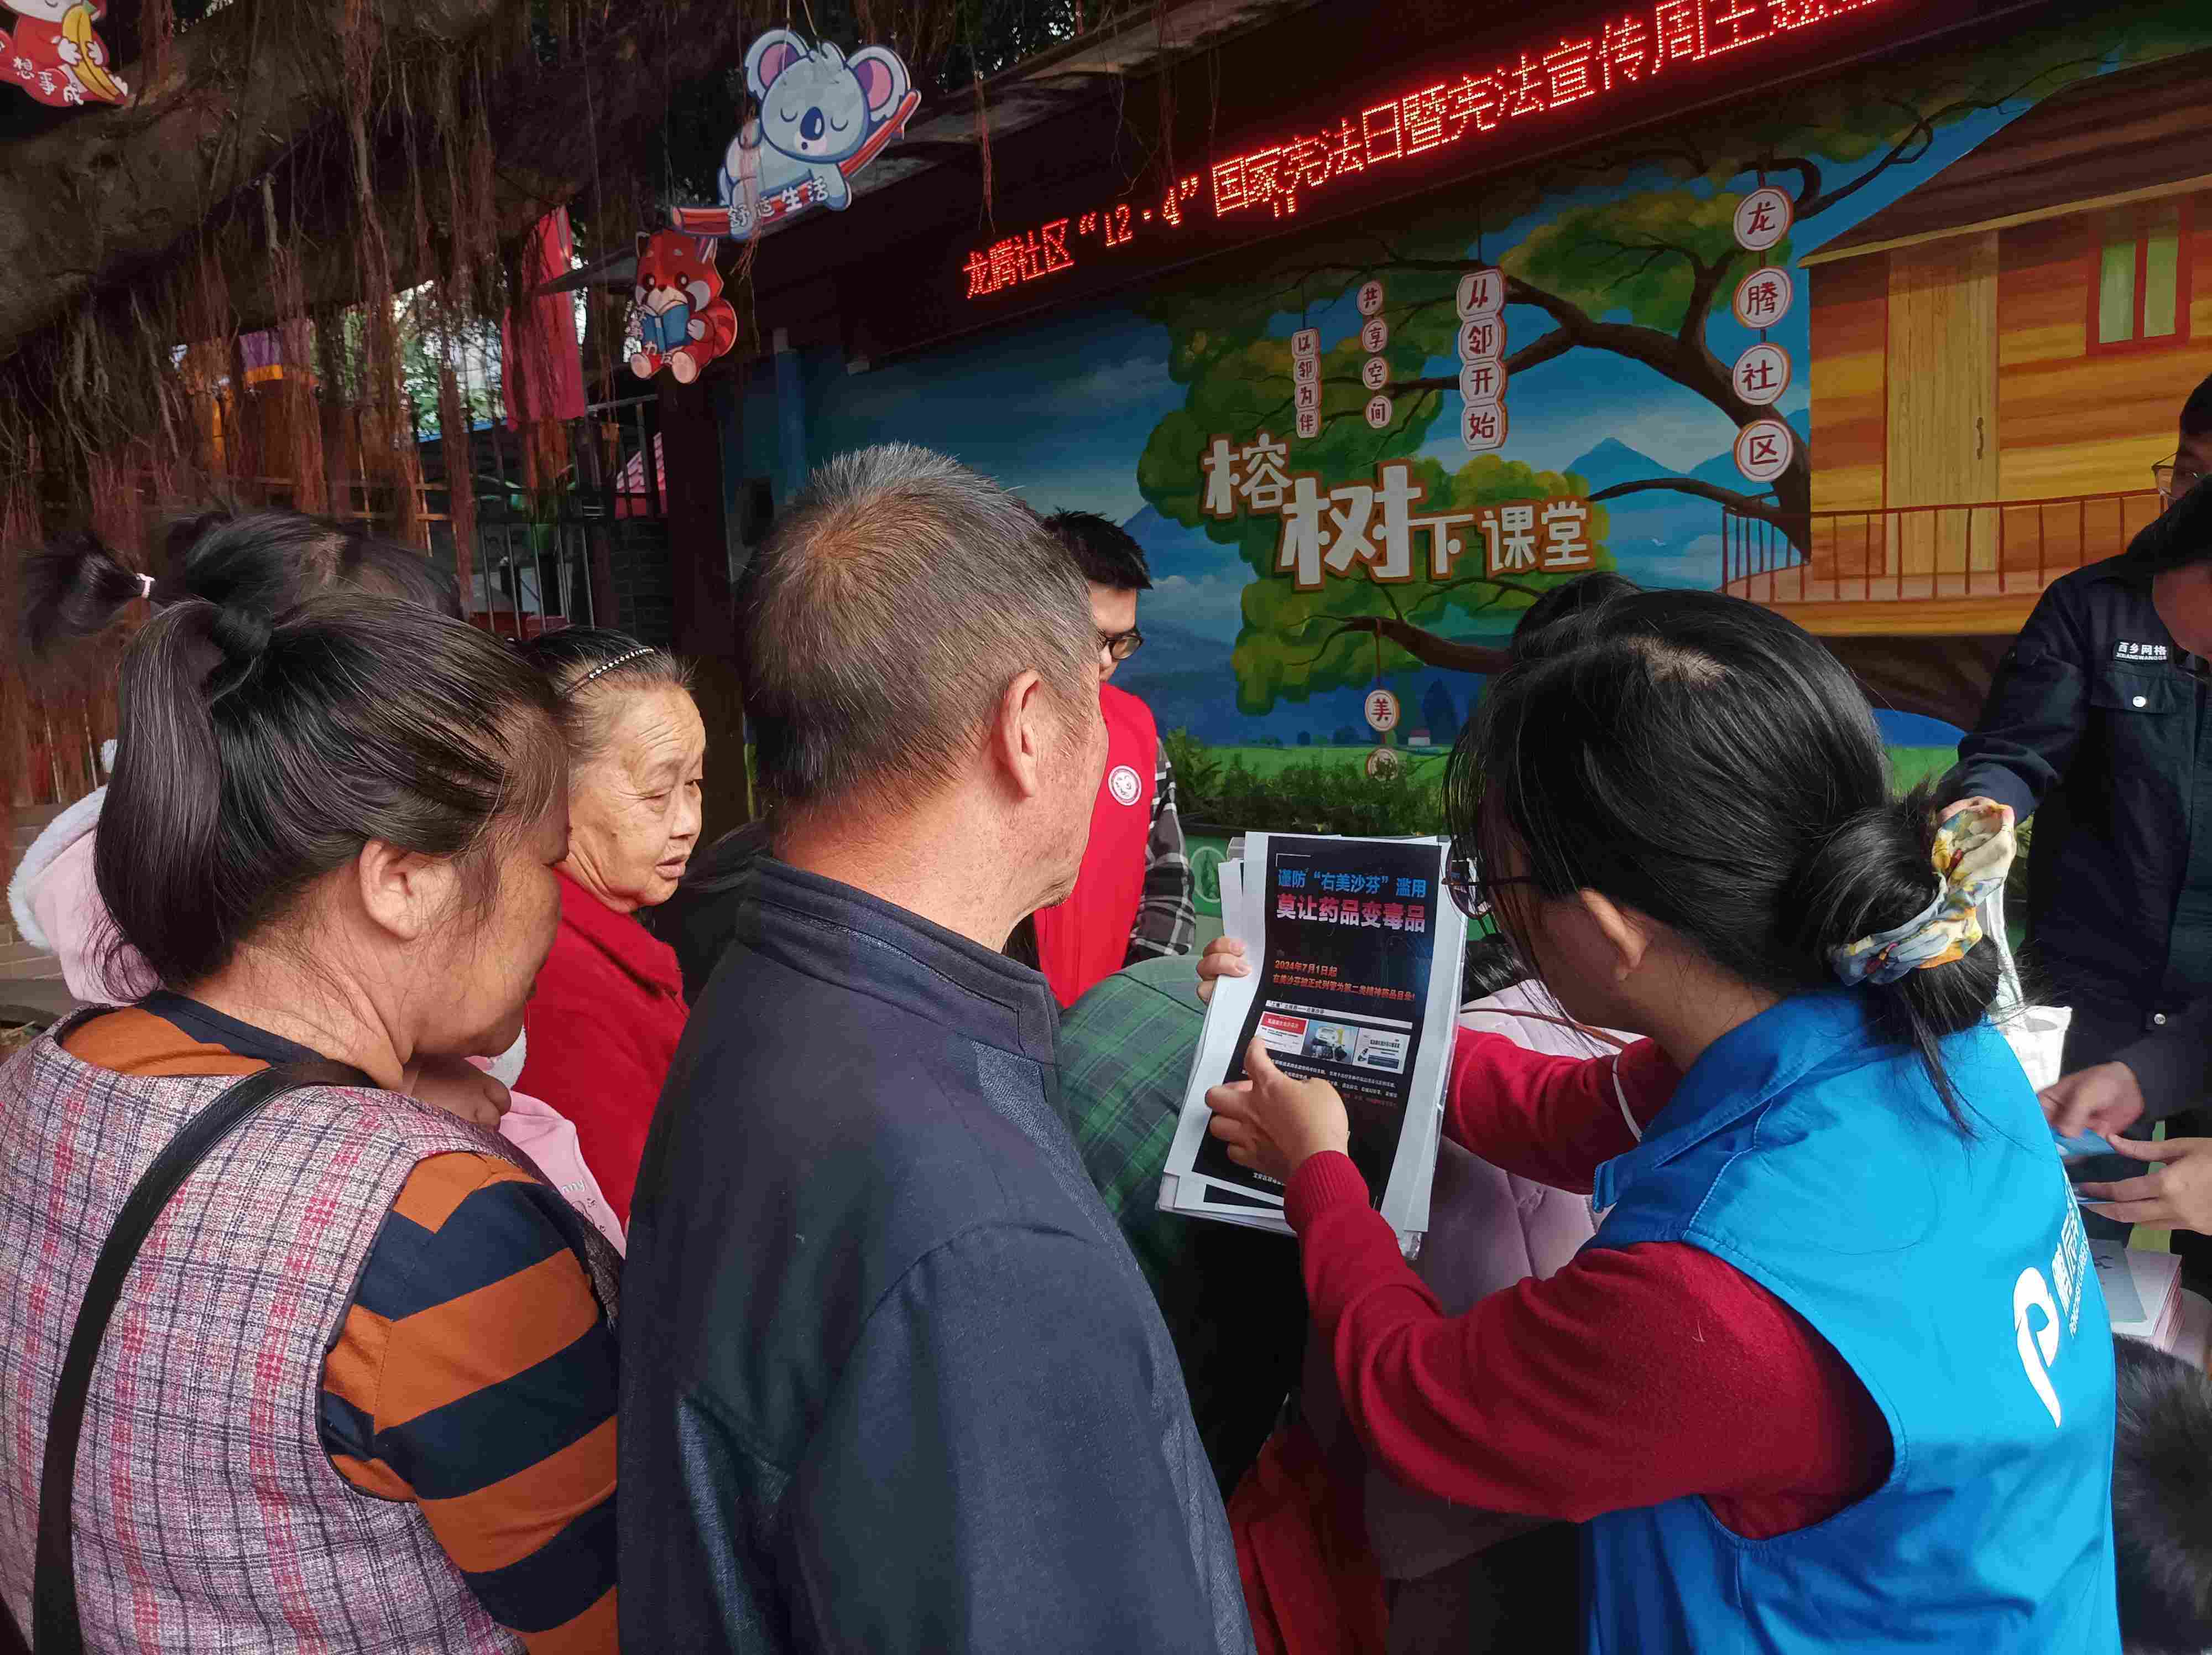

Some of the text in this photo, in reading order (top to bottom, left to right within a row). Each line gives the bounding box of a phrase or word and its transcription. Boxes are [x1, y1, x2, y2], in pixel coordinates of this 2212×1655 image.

[0, 39, 85, 106] 想事成
[727, 175, 829, 227] 舒适生活
[1363, 287, 1386, 423] 共享空间
[1466, 278, 1496, 440] 从邻开始
[1740, 201, 1779, 465] 龙腾社区
[1296, 335, 1314, 433] 以邻为伴
[1203, 433, 1594, 585] 榕树下课堂
[2118, 642, 2167, 655] 西乡网格
[1276, 893, 1426, 933] 莫让药品变毒品
[1275, 960, 1338, 977] 2024年7月1日起
